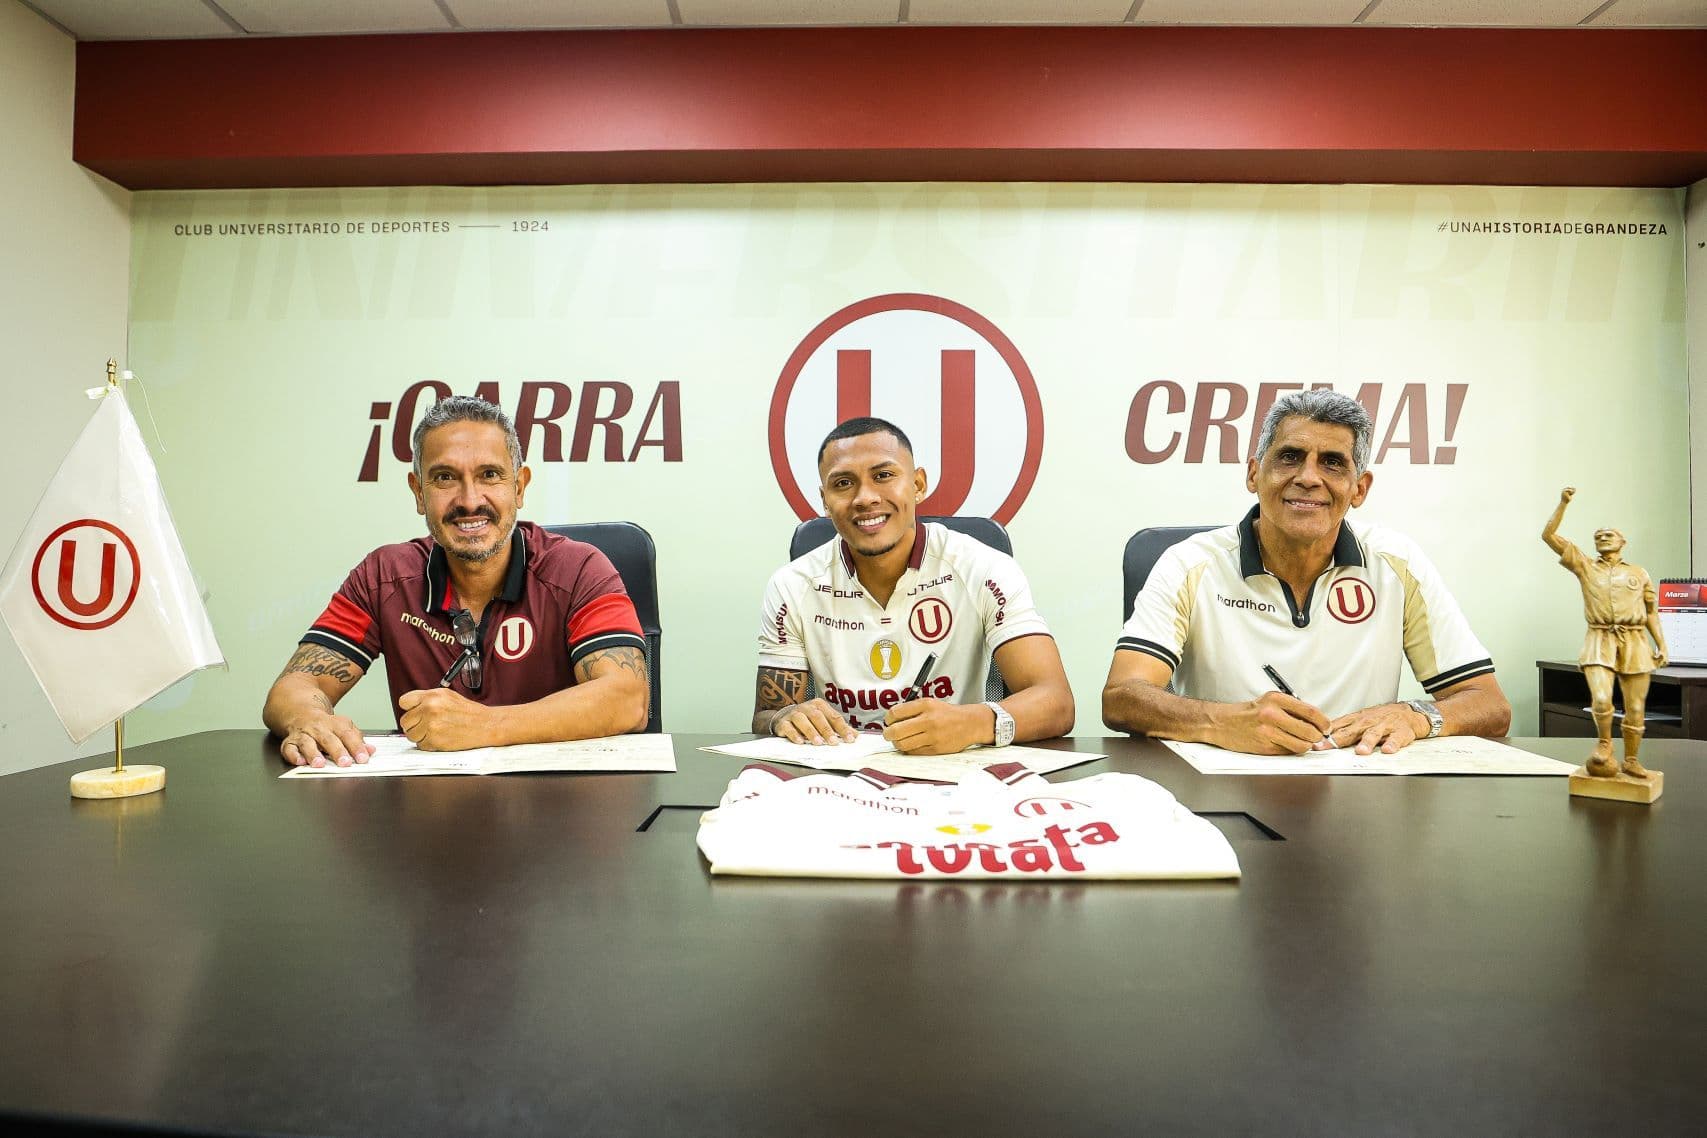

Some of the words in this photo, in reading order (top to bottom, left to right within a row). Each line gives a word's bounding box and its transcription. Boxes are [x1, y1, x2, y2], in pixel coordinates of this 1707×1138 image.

[174, 223, 213, 236] CLUB
[218, 222, 340, 235] UNIVERSITARIO
[346, 222, 366, 234] DE
[371, 221, 450, 234] DEPORTES
[512, 220, 549, 232] 1924
[1437, 221, 1668, 235] #UNAHISTORIADEGRANDEZA
[357, 380, 684, 482] ¡GRRA
[57, 540, 117, 616] U
[814, 584, 864, 599] JEOUR
[400, 612, 456, 646] marathon
